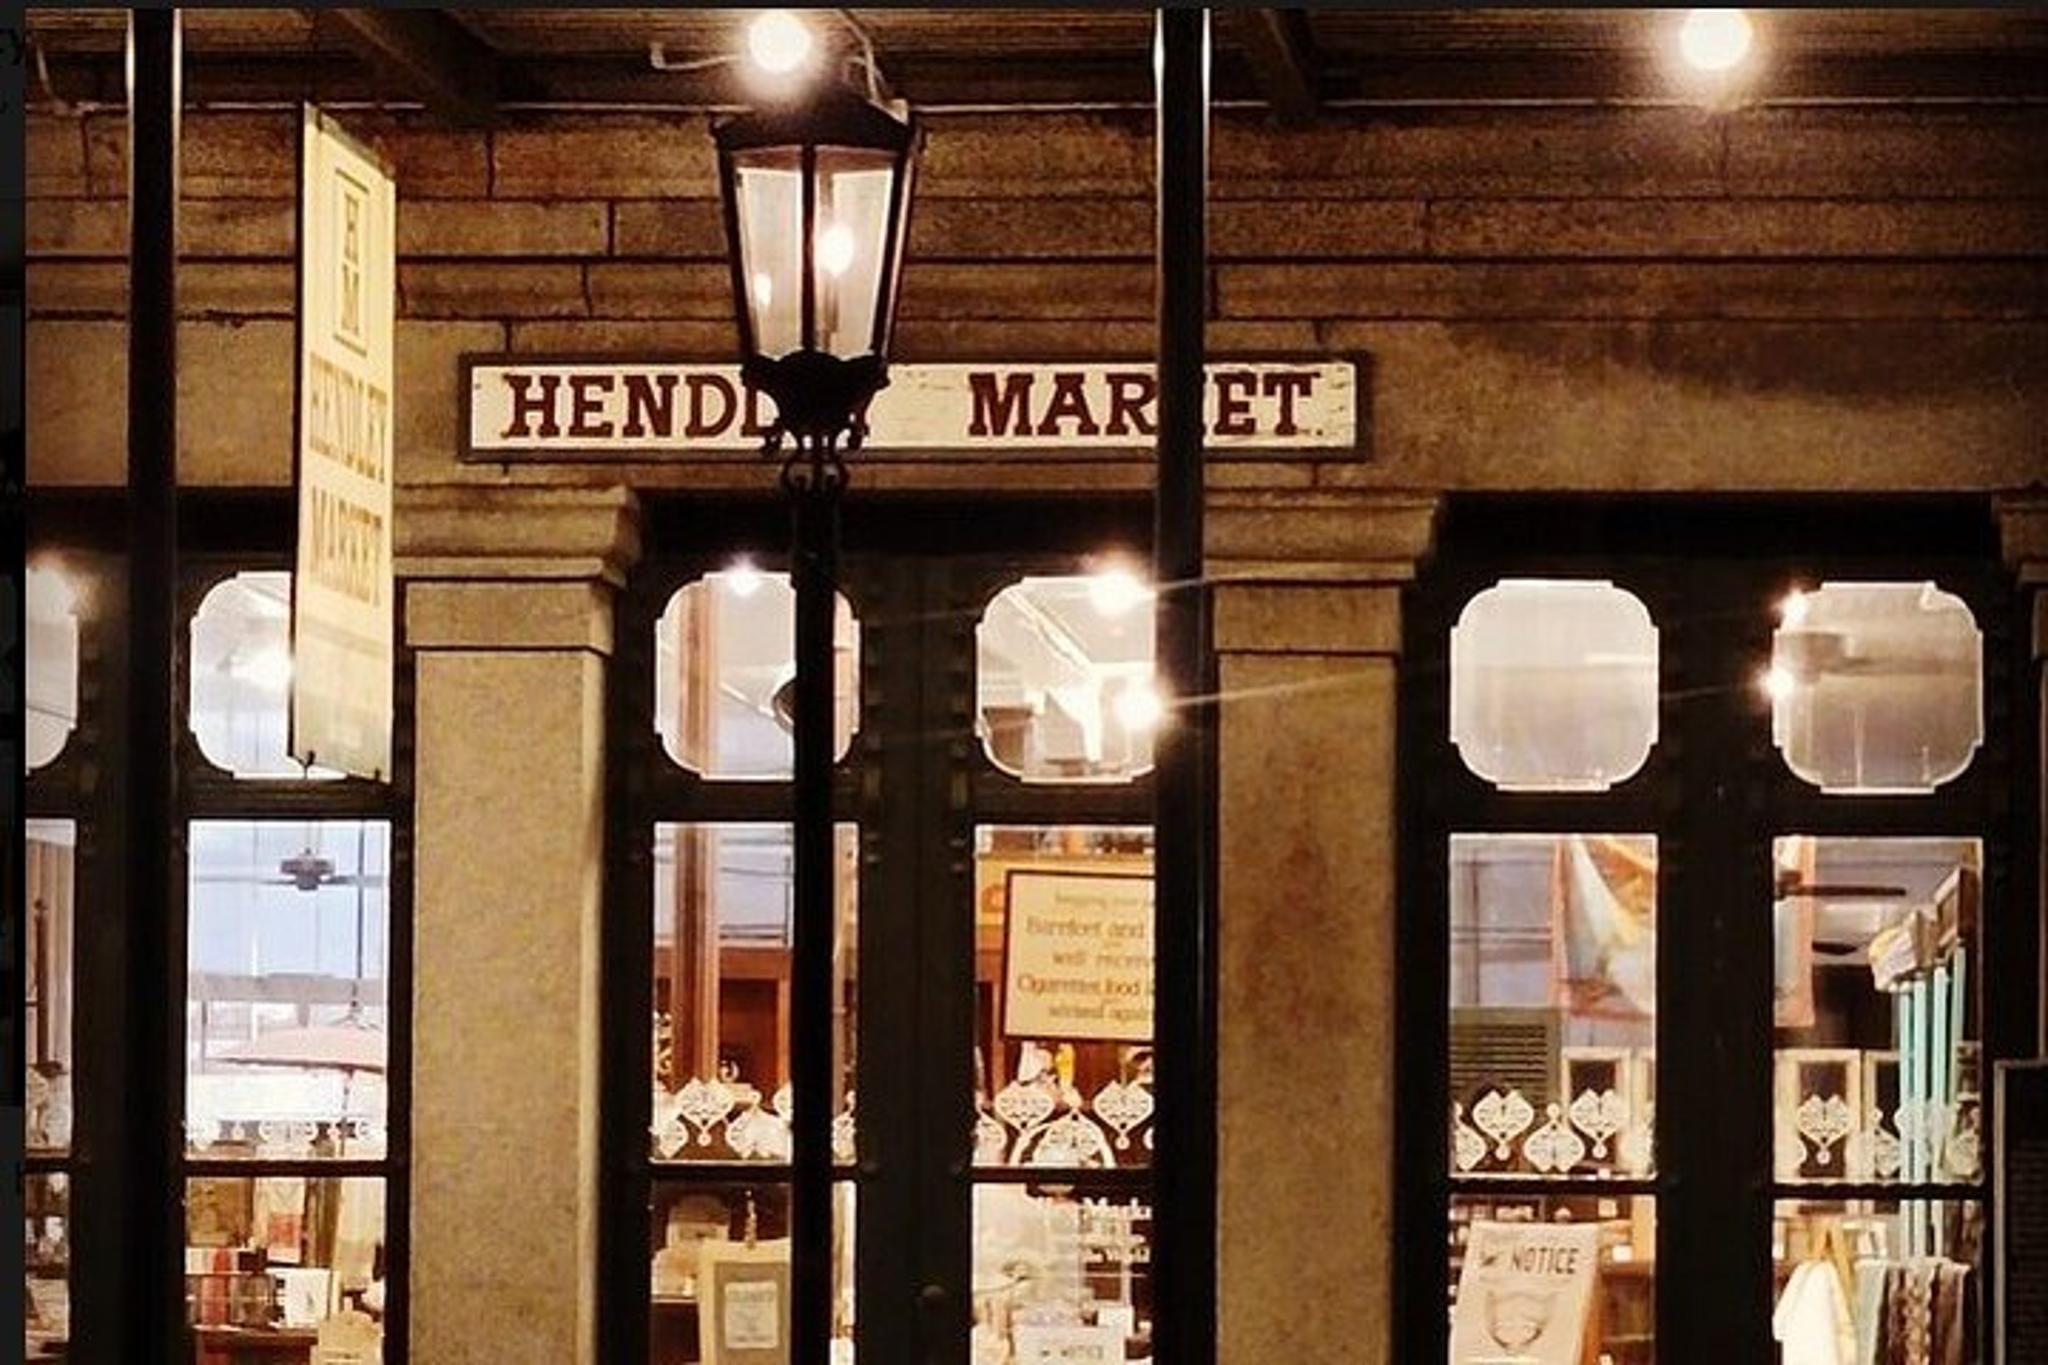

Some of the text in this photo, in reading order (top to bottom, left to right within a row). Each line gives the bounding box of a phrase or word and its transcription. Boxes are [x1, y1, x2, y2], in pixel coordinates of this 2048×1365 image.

[501, 372, 1321, 438] HENDL MARET
[1509, 1246, 1580, 1275] NOTICE
